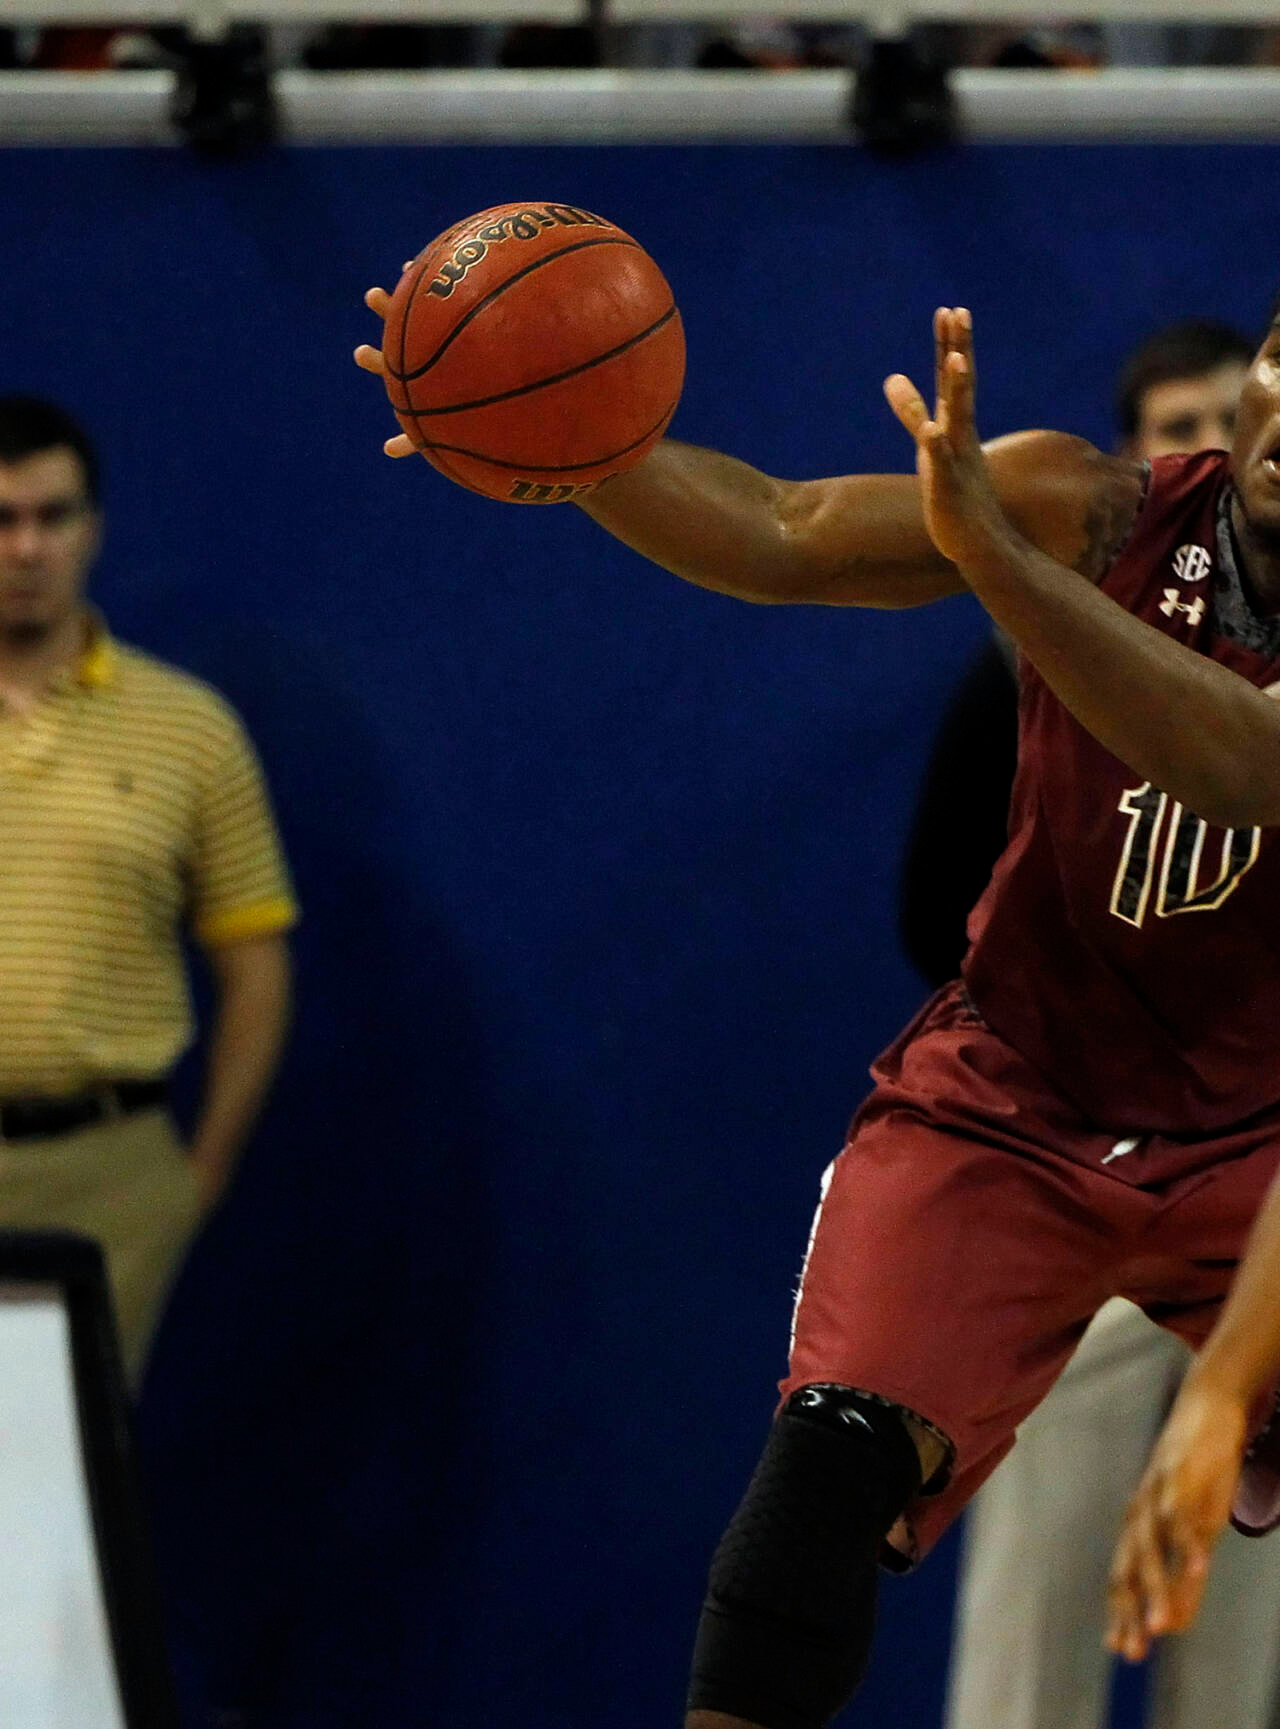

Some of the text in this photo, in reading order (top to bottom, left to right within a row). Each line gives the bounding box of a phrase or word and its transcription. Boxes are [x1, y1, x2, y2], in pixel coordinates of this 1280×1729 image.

[425, 204, 614, 300] Wilson
[1172, 544, 1212, 582] SEC
[1110, 781, 1261, 929] 10
